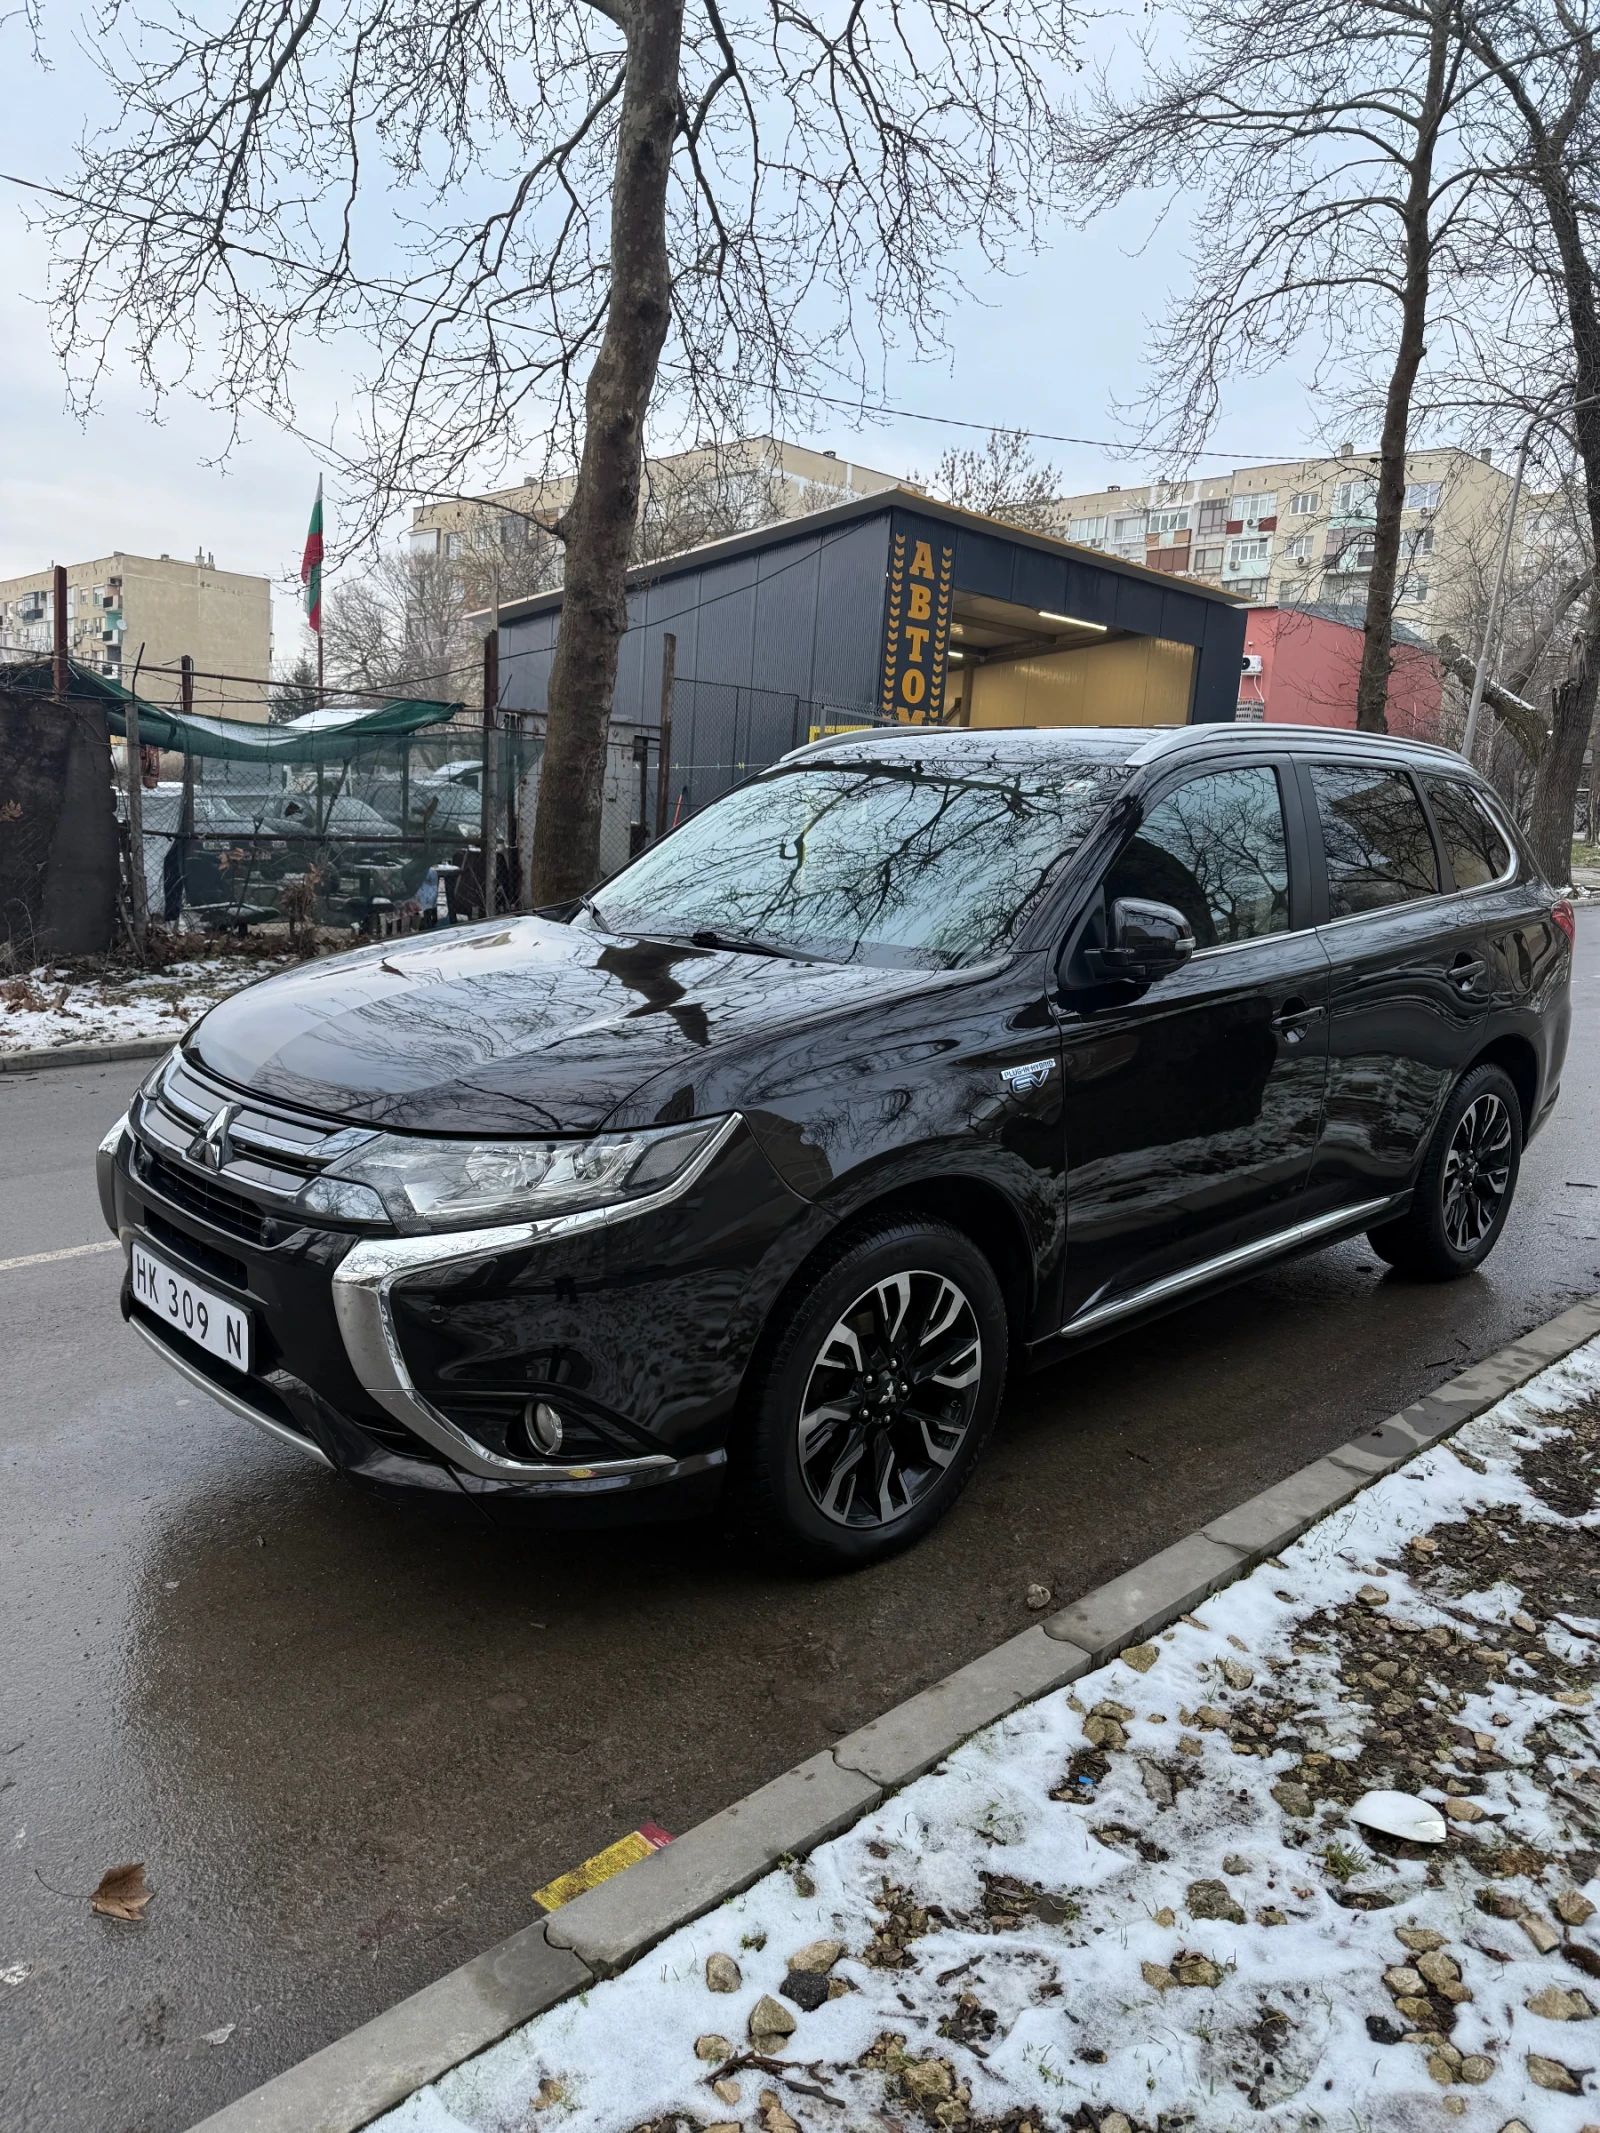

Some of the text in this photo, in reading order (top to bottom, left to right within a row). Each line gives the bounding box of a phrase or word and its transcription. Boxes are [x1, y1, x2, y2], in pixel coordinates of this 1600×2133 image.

[136, 1253, 242, 1360] HK 309 N
